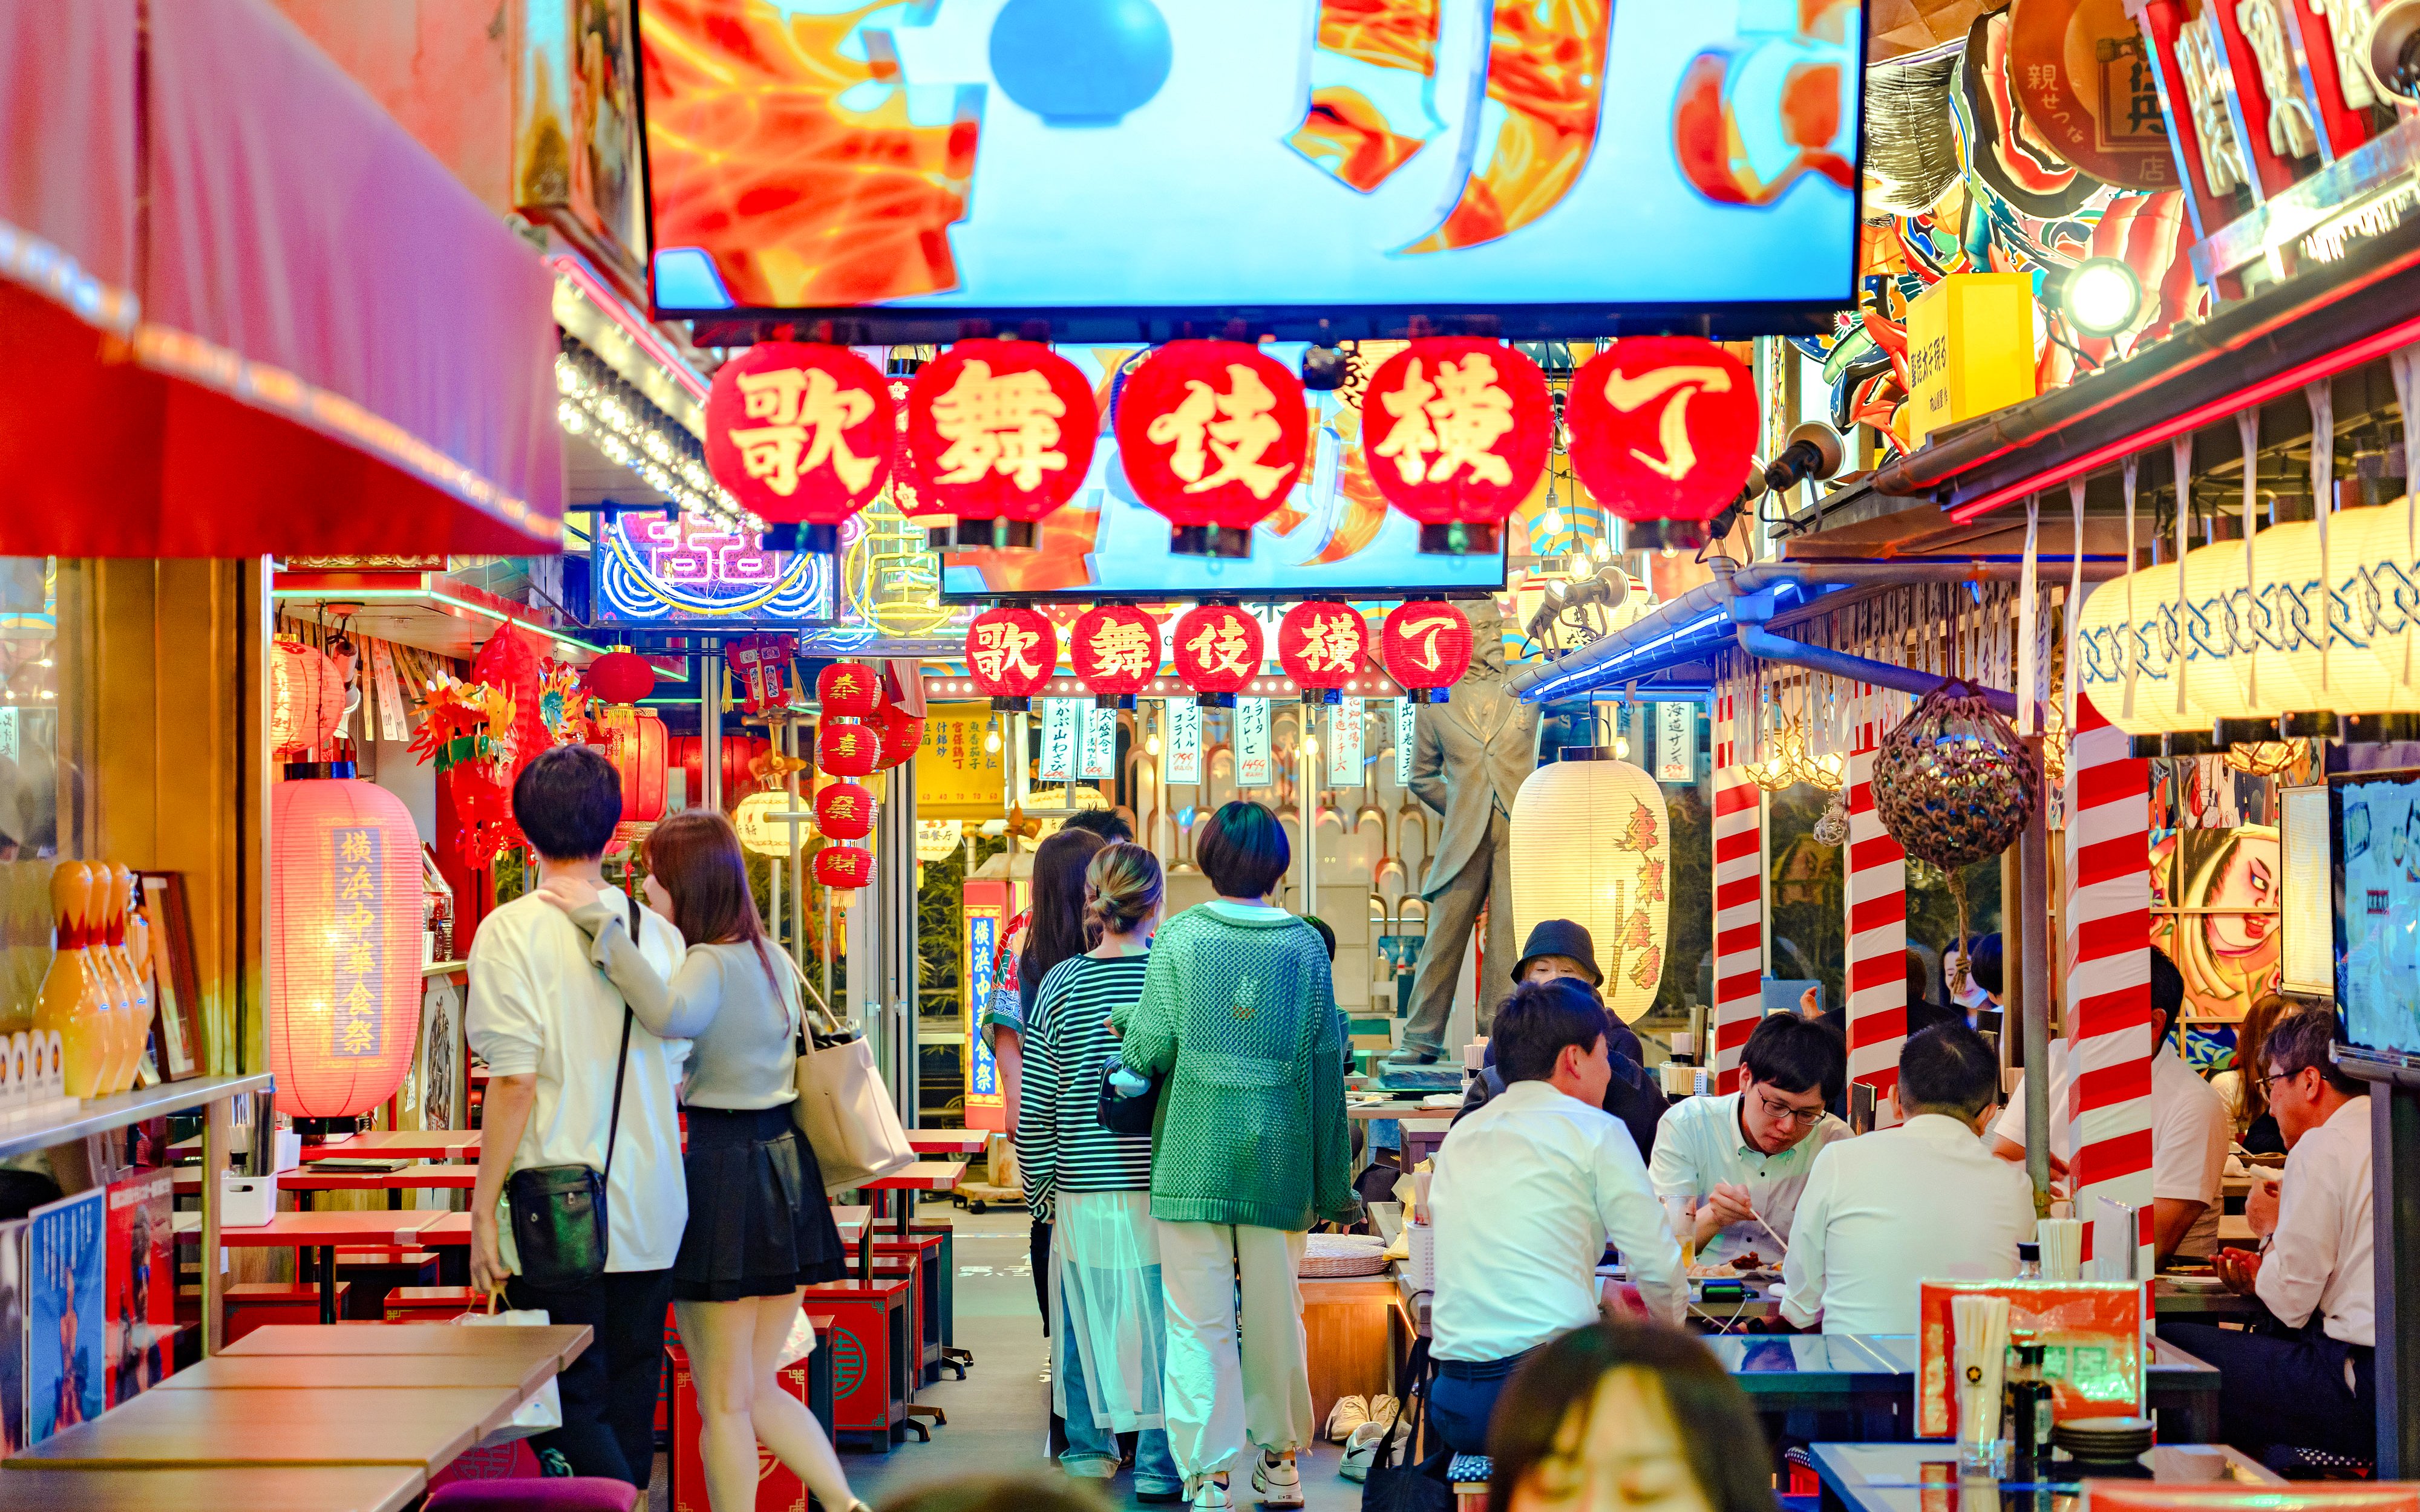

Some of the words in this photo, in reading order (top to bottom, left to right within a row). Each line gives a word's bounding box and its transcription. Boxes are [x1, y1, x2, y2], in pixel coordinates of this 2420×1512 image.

[728, 351, 1735, 501] 歌舞伎横丁
[972, 613, 1459, 682] 歌舞伎横丁
[1097, 708, 1113, 755] ズ盛合せ
[1173, 714, 1182, 749] フライ
[1334, 706, 1347, 772] 手造りチーズ
[1241, 760, 1266, 771] 1499
[340, 830, 376, 1055] 横浜中華食祭
[1607, 947, 1621, 997] SHOKUSAI
